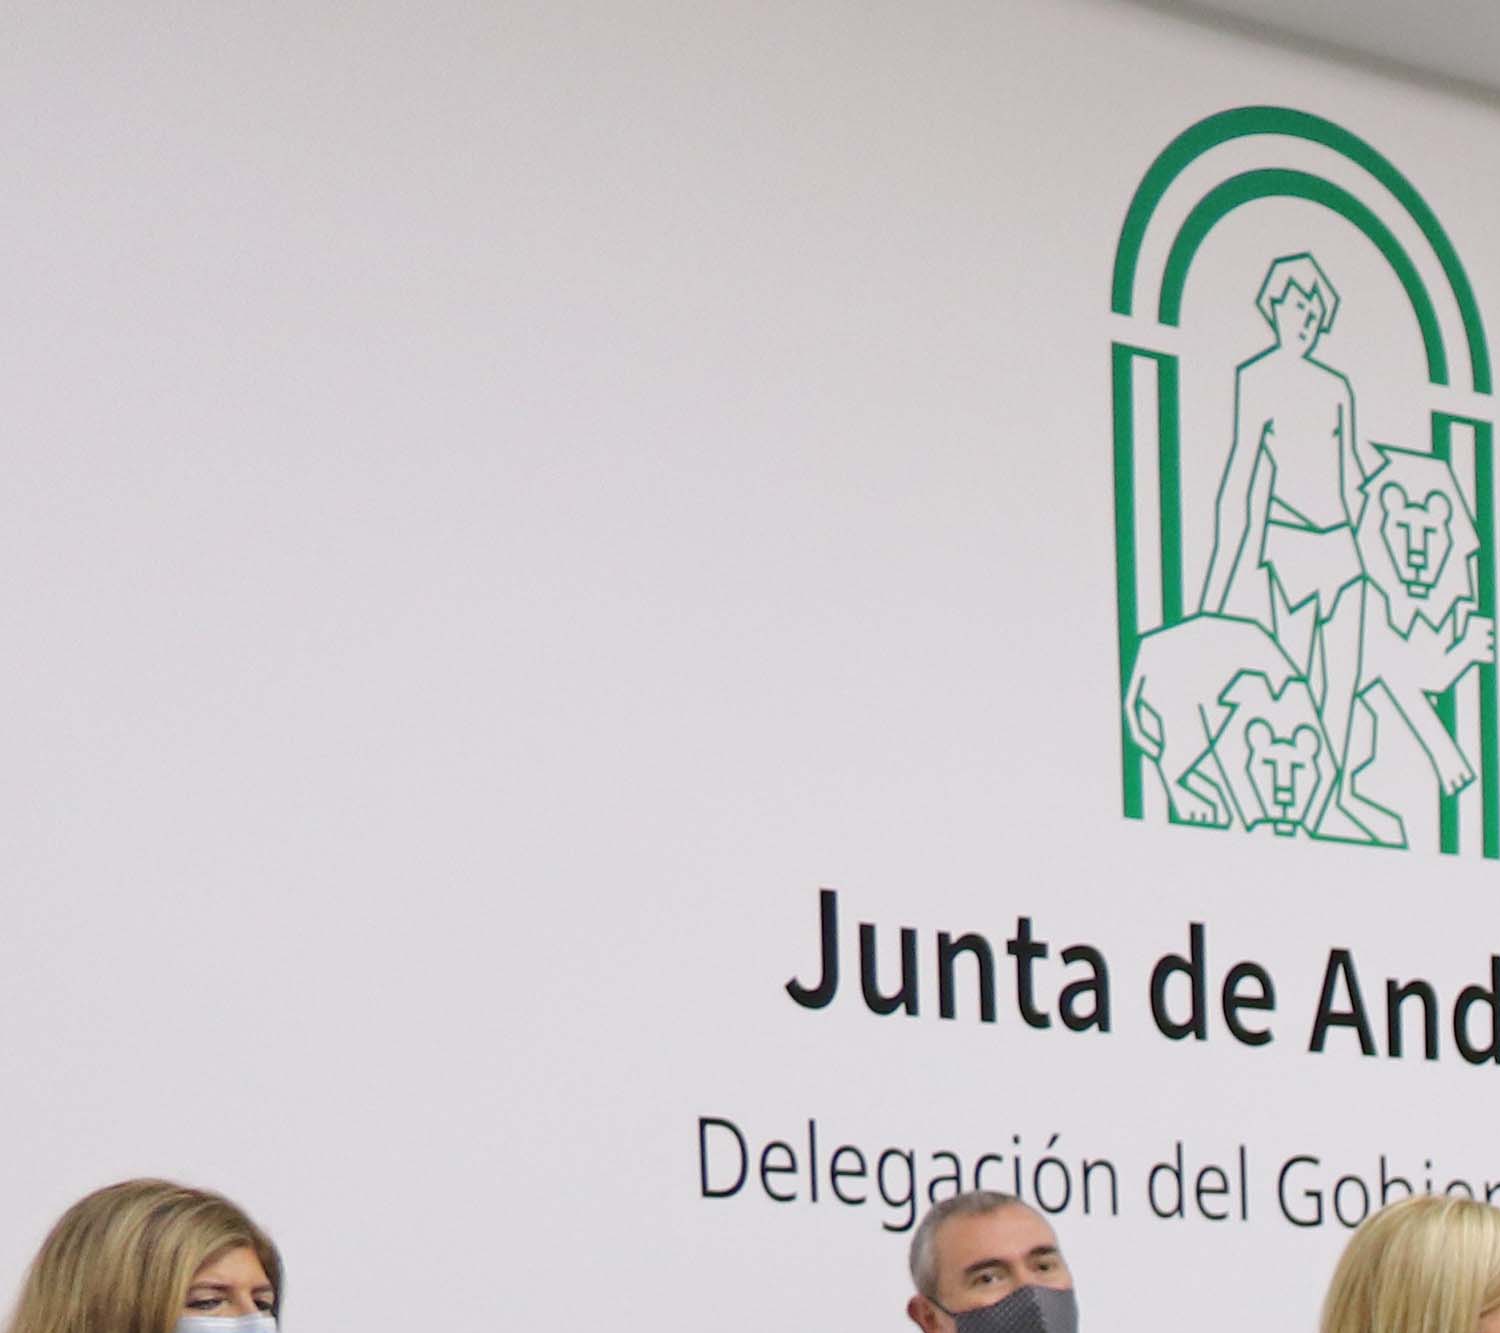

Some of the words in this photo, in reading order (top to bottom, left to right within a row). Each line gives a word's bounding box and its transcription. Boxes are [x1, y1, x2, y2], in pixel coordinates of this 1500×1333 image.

[783, 887, 1111, 1034] Junta
[1148, 920, 1277, 1049] de
[1146, 1140, 1248, 1221] del
